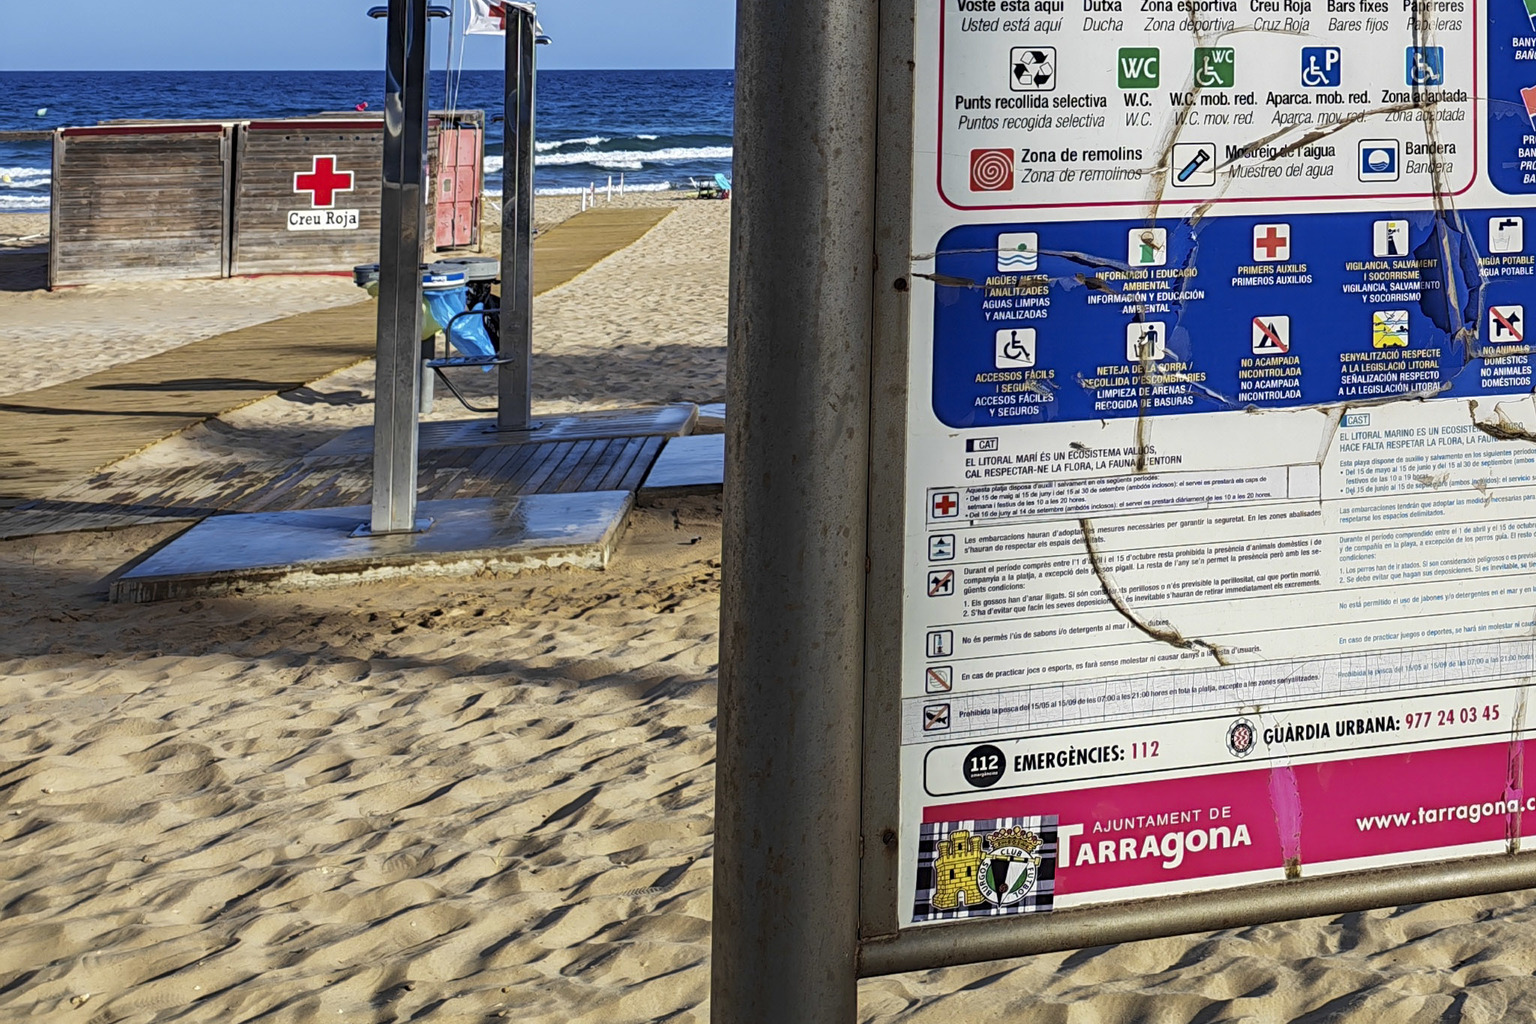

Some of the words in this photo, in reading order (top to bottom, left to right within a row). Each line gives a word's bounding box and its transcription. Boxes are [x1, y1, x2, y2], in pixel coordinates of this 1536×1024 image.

[1250, 0, 1281, 12] Creu
[1284, 0, 1311, 15] Roja
[1327, 0, 1355, 13] Bars
[1359, 0, 1388, 13] fixes
[961, 18, 998, 32] Usted
[1001, 17, 1028, 32] está
[1033, 17, 1062, 34] aquí
[1083, 18, 1123, 32] Ducha
[1144, 17, 1175, 31] Zona
[1179, 17, 1235, 34] deportiva
[1254, 18, 1282, 32] Cruz
[1284, 18, 1310, 34] Roja
[1328, 18, 1362, 32] Bares
[1365, 18, 1389, 34] fijos
[1513, 38, 1536, 47] BANY
[1211, 50, 1233, 64] WC
[1326, 50, 1339, 71] P
[1121, 58, 1157, 79] WC
[955, 95, 991, 109] Punts
[995, 94, 1049, 109] recollida
[1052, 94, 1107, 108] selectiva
[1124, 93, 1152, 107] W.C.
[1170, 93, 1197, 107] W.C.
[1201, 92, 1231, 106] mob.
[1234, 91, 1258, 106] red.
[1266, 91, 1312, 107] Aparca.
[1316, 91, 1345, 105] mob.
[1349, 90, 1371, 104] red.
[1382, 90, 1410, 103] Zona
[958, 115, 999, 130] Puntos
[1002, 114, 1052, 132] recogida
[1055, 114, 1105, 128] selectiva
[1126, 112, 1152, 126] W.C.
[1175, 112, 1201, 126] W.C.
[1204, 112, 1230, 126] mov.
[1233, 111, 1254, 125] red.
[1271, 110, 1314, 127] Aparca.
[1021, 149, 1056, 163] Zona
[1060, 148, 1077, 163] de
[1083, 147, 1142, 162] remolins
[1405, 141, 1456, 155] Bandera
[1021, 168, 1054, 183] Zona
[1059, 167, 1075, 182] de
[1079, 166, 1142, 182] remolinos
[1229, 164, 1283, 178] Muestreo
[1286, 163, 1304, 177] del
[1306, 164, 1334, 179] agua
[1406, 160, 1453, 174] Bandera
[289, 212, 321, 226] Creu
[326, 211, 356, 228] Roja
[1238, 265, 1274, 275] PRIMERS
[1276, 264, 1307, 274] AUXILIS
[1232, 276, 1274, 286] PRIMEROS
[1275, 274, 1312, 285] AUXILIOS
[1348, 416, 1368, 425] CAST
[979, 440, 996, 450] CAT
[1340, 442, 1361, 452] HACE
[1362, 441, 1384, 451] FALTA
[1386, 439, 1425, 450] RESPETAR
[1427, 437, 1436, 447] LA
[1438, 436, 1464, 447] FLORA,
[1466, 435, 1475, 444] LA
[965, 458, 976, 467] EL
[979, 455, 1014, 466] LITORAL
[1016, 452, 1038, 464] MARÍ
[1040, 450, 1051, 462] ÉS
[1054, 451, 1065, 461] UN
[1068, 448, 1121, 460] ECOSISTEMA
[965, 469, 982, 479] CAL
[984, 465, 1049, 477] RESPECTAR-NE
[1051, 463, 1062, 473] LA
[1064, 461, 1094, 473] FLORA,
[1096, 460, 1106, 470] LA
[1108, 458, 1136, 469] FAUNA
[1263, 720, 1330, 745] GUÀRDIA
[1336, 716, 1401, 738] URBANA:
[1405, 711, 1432, 730] 977
[1438, 709, 1455, 727] 24
[1460, 707, 1477, 724] 03
[1482, 704, 1500, 721] 45
[970, 755, 998, 772] 112
[1014, 746, 1125, 772] EMERGÈNCIES:
[1131, 741, 1160, 760] 112
[1092, 809, 1202, 834] AJUNTAMENT
[1209, 806, 1232, 819] DE
[1001, 848, 1022, 856] CLUB
[979, 862, 992, 897] BURGOS
[1013, 867, 1035, 898] FUTBOL
